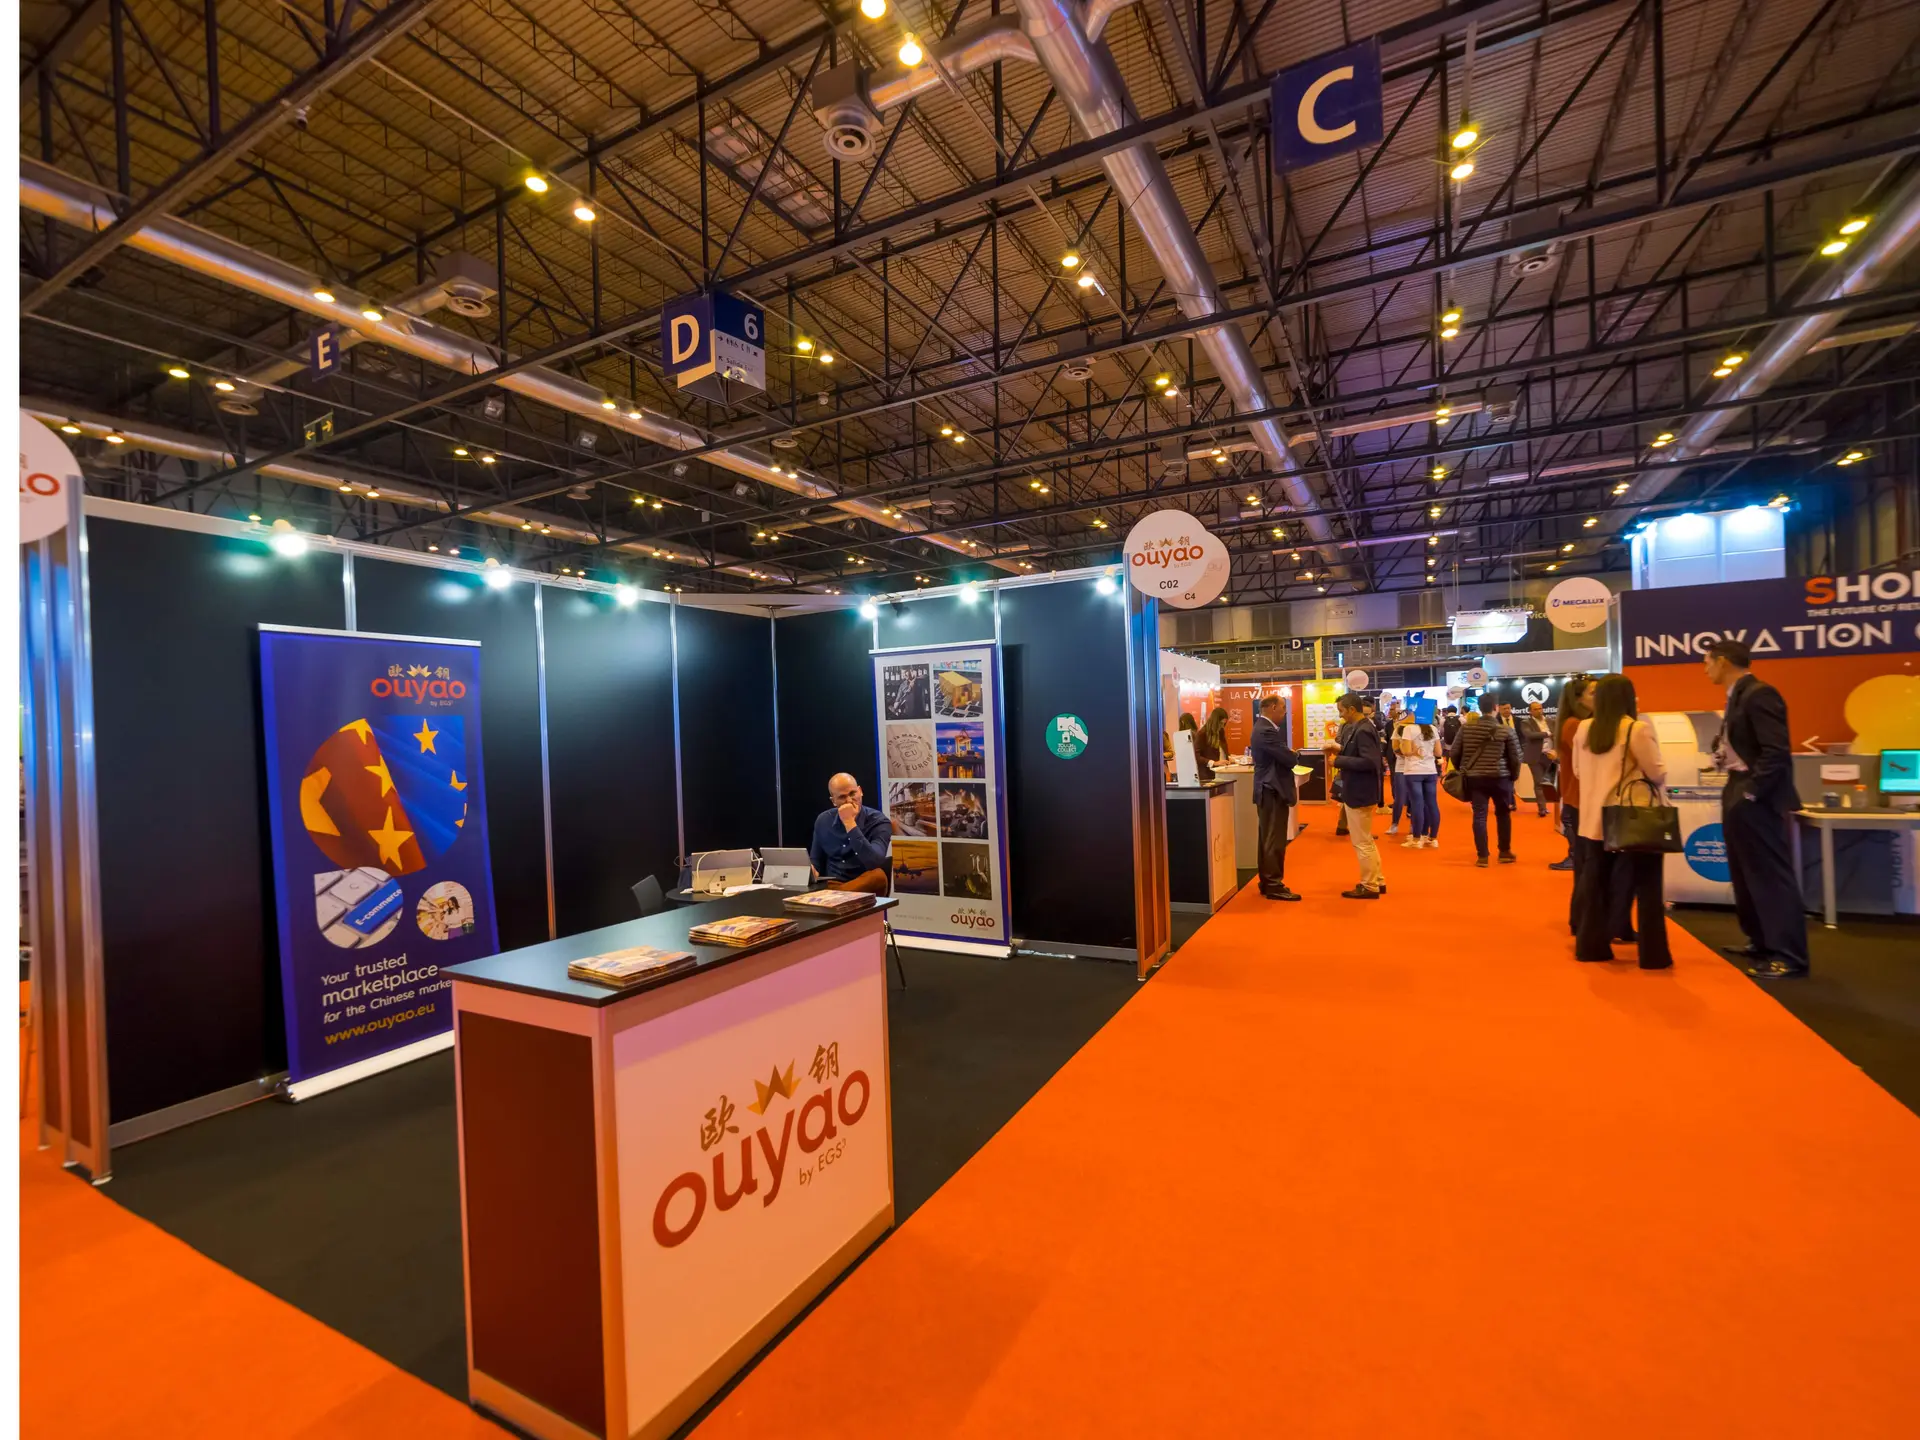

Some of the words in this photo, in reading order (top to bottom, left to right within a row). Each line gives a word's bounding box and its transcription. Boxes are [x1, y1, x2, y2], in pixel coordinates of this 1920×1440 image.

[1297, 65, 1357, 144] C
[670, 314, 700, 365] D
[744, 313, 759, 340] 6
[317, 332, 333, 370] E
[1131, 545, 1204, 568] ouyao
[1159, 579, 1179, 589] C02
[1184, 592, 1196, 600] C4
[1562, 598, 1604, 606] MECALUX
[1806, 608, 1830, 617] THE
[1292, 639, 1302, 649] D
[1409, 632, 1420, 644] C
[370, 678, 466, 704] ouyao
[355, 888, 403, 925] E-commerce
[950, 914, 995, 929] ouyao
[321, 970, 350, 986] Your
[355, 953, 408, 978] trusted
[322, 964, 438, 1007] marketplace
[323, 1010, 342, 1025] for
[346, 1004, 366, 1018] the
[370, 990, 415, 1009] Chinese
[419, 978, 452, 996] marke
[324, 1002, 435, 1045] www.ouyao.eu
[700, 1094, 740, 1151] 欧
[808, 1041, 840, 1084] 钥
[652, 1069, 871, 1249] ouyao
[799, 1167, 815, 1187] by
